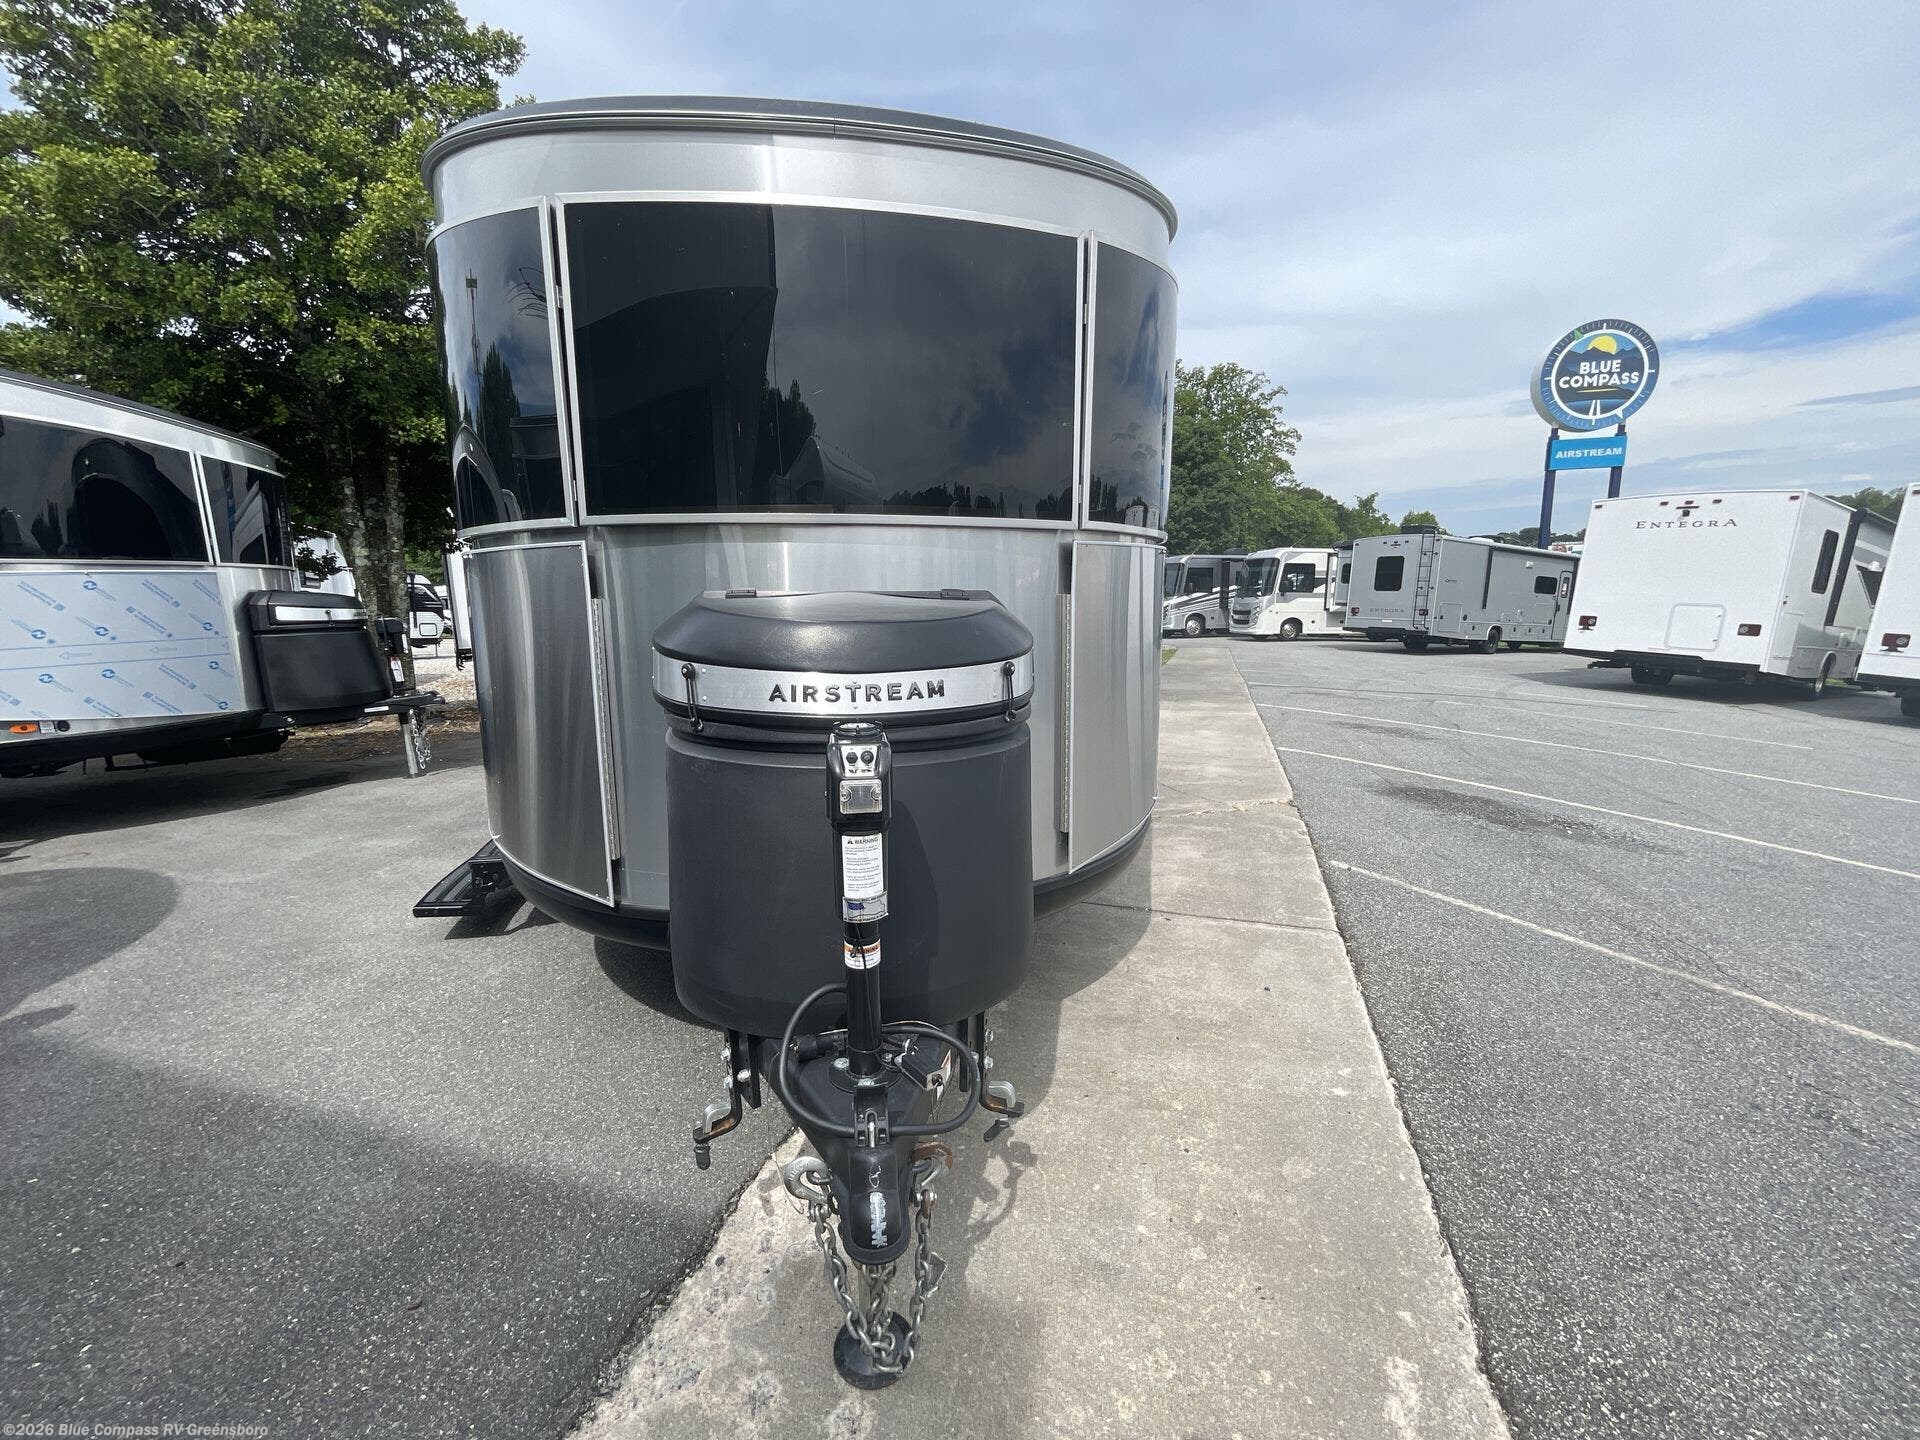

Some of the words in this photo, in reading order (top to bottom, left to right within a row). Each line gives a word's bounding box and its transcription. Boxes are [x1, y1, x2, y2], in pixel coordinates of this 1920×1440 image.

[1580, 359, 1622, 375] BLUE
[1559, 371, 1640, 389] COMPASS
[1555, 447, 1622, 459] AIRSTREAM
[1635, 518, 1738, 529] ENTEGRA
[768, 679, 946, 703] AIRSTREAM
[854, 837, 879, 845] WARNING
